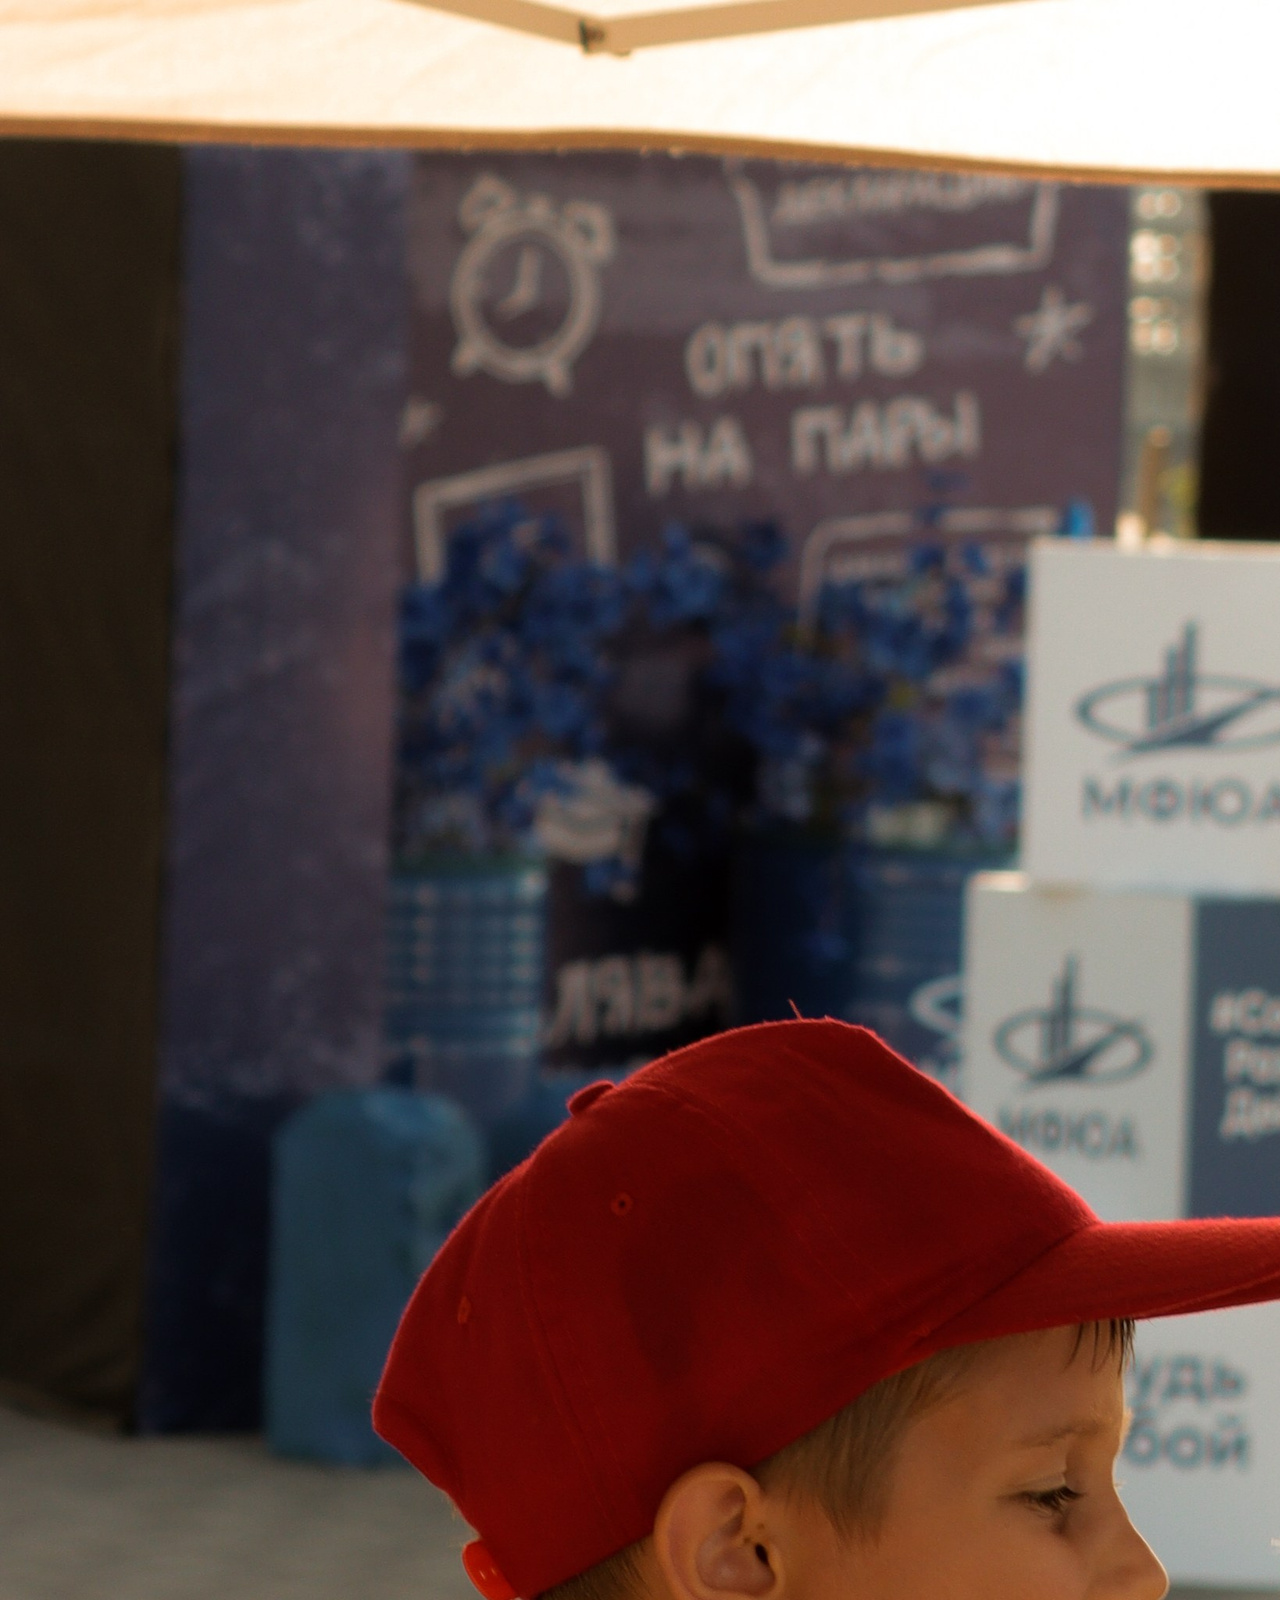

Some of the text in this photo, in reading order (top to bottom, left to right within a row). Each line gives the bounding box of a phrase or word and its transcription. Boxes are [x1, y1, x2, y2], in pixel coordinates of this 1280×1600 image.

[687, 314, 924, 399] ОПЯТЬ
[643, 391, 983, 497] НА ПАРЫ
[1127, 1354, 1248, 1408] удь
